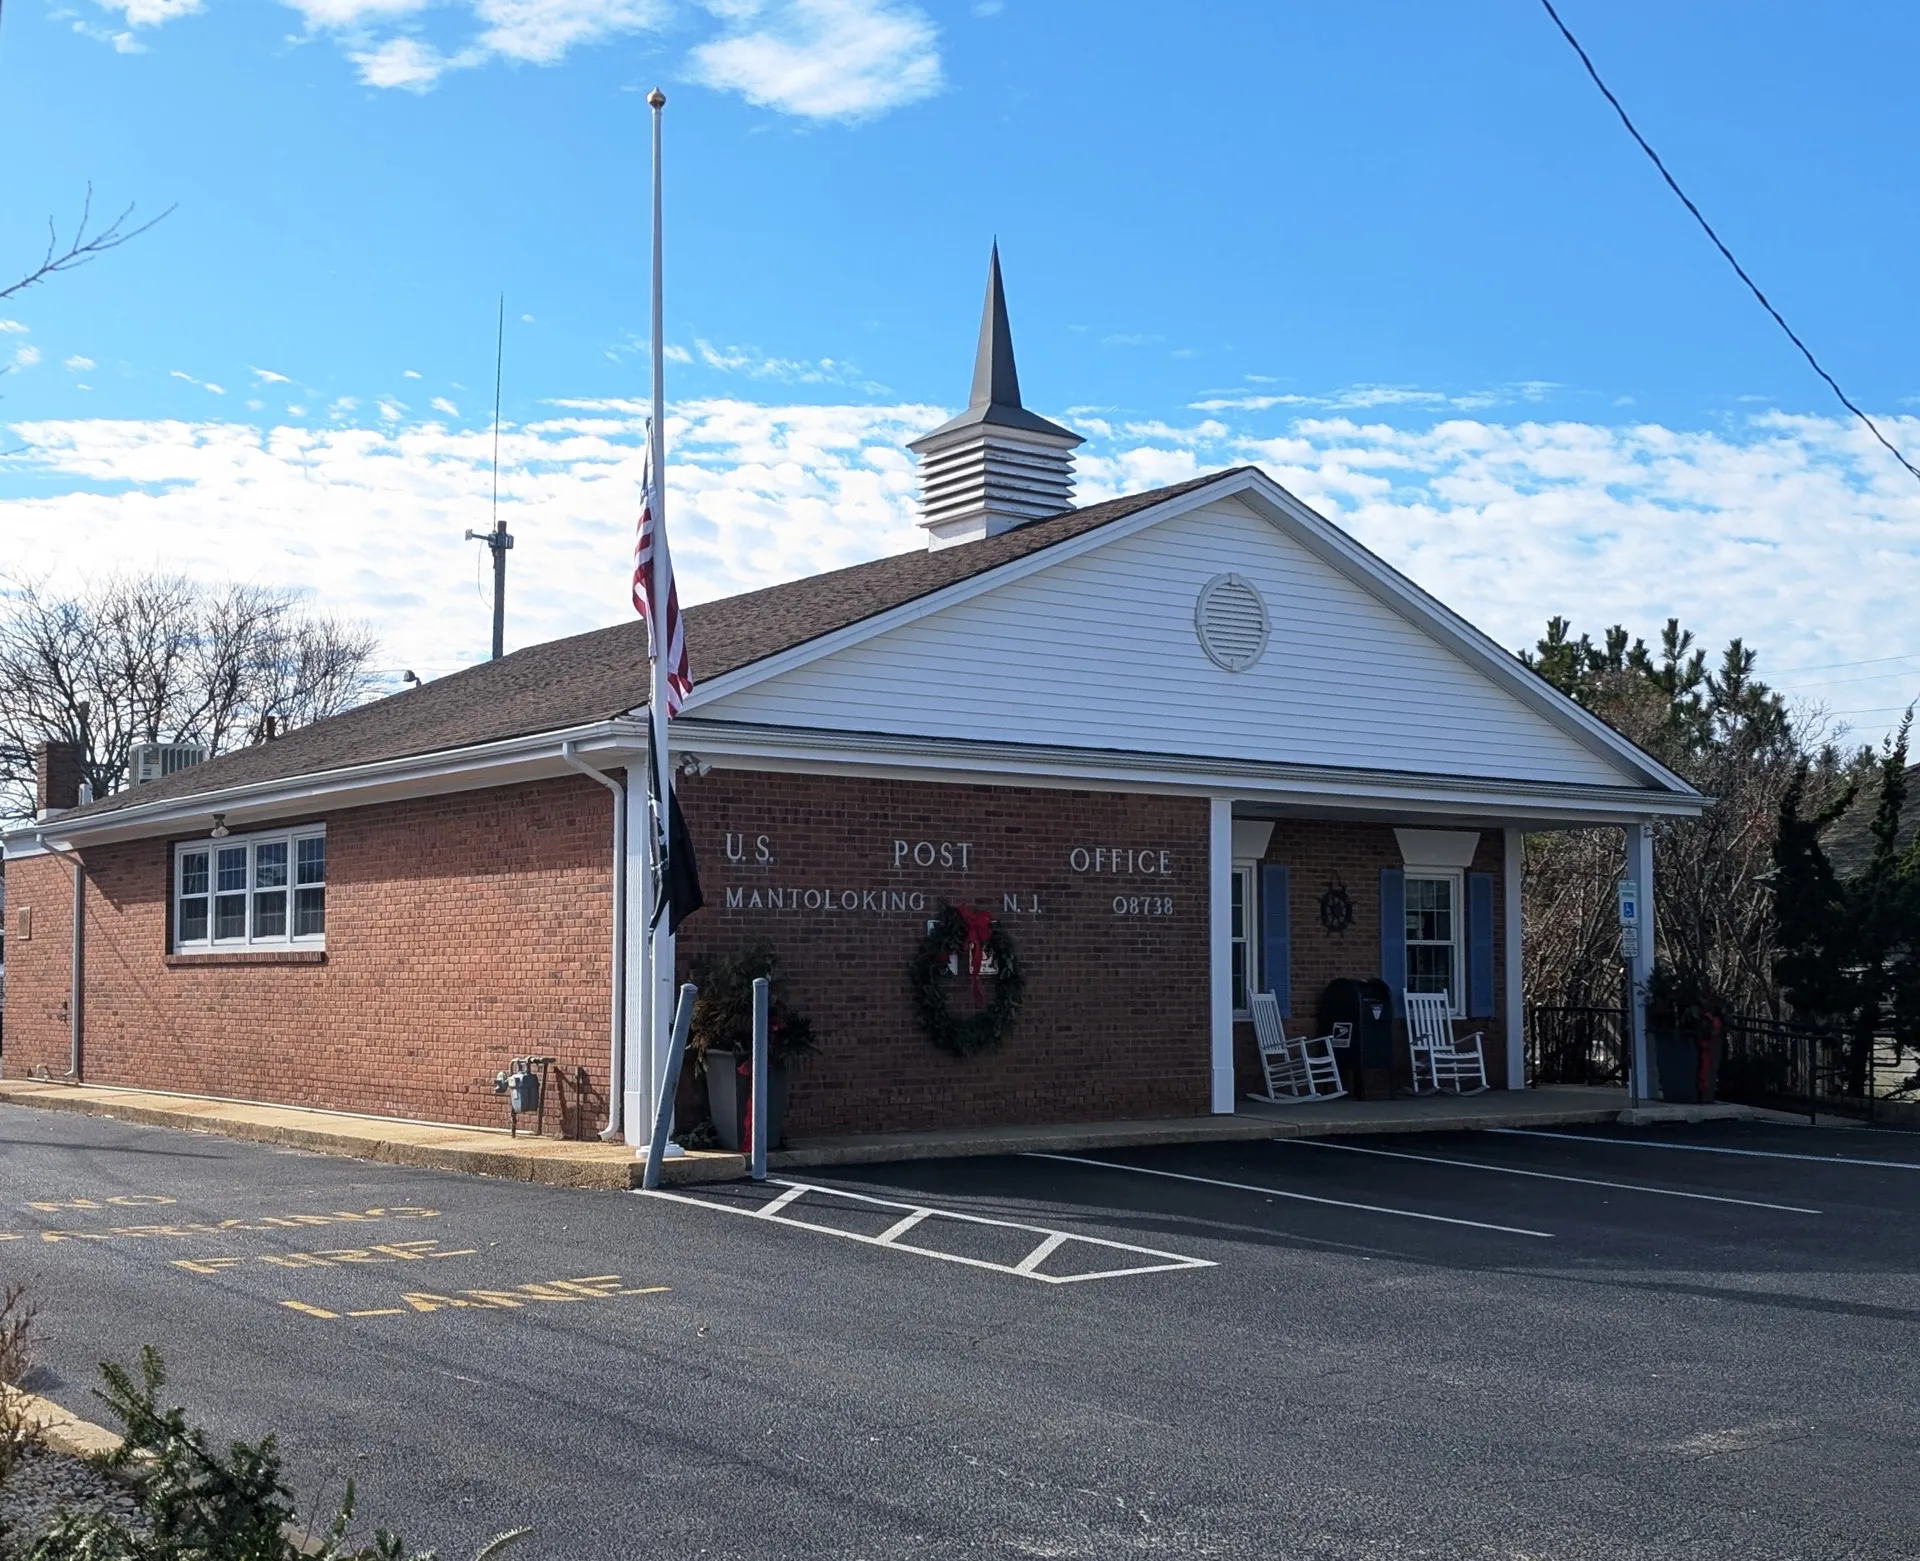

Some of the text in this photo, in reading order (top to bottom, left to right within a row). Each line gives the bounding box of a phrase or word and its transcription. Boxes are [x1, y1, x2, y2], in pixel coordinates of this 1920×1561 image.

[893, 840, 973, 869] POST
[1070, 847, 1173, 875] OFFICE
[725, 886, 926, 911] MANTOLOKING
[22, 1194, 177, 1212] NO
[169, 1239, 477, 1274] FIRE
[278, 1275, 672, 1319] LANE
